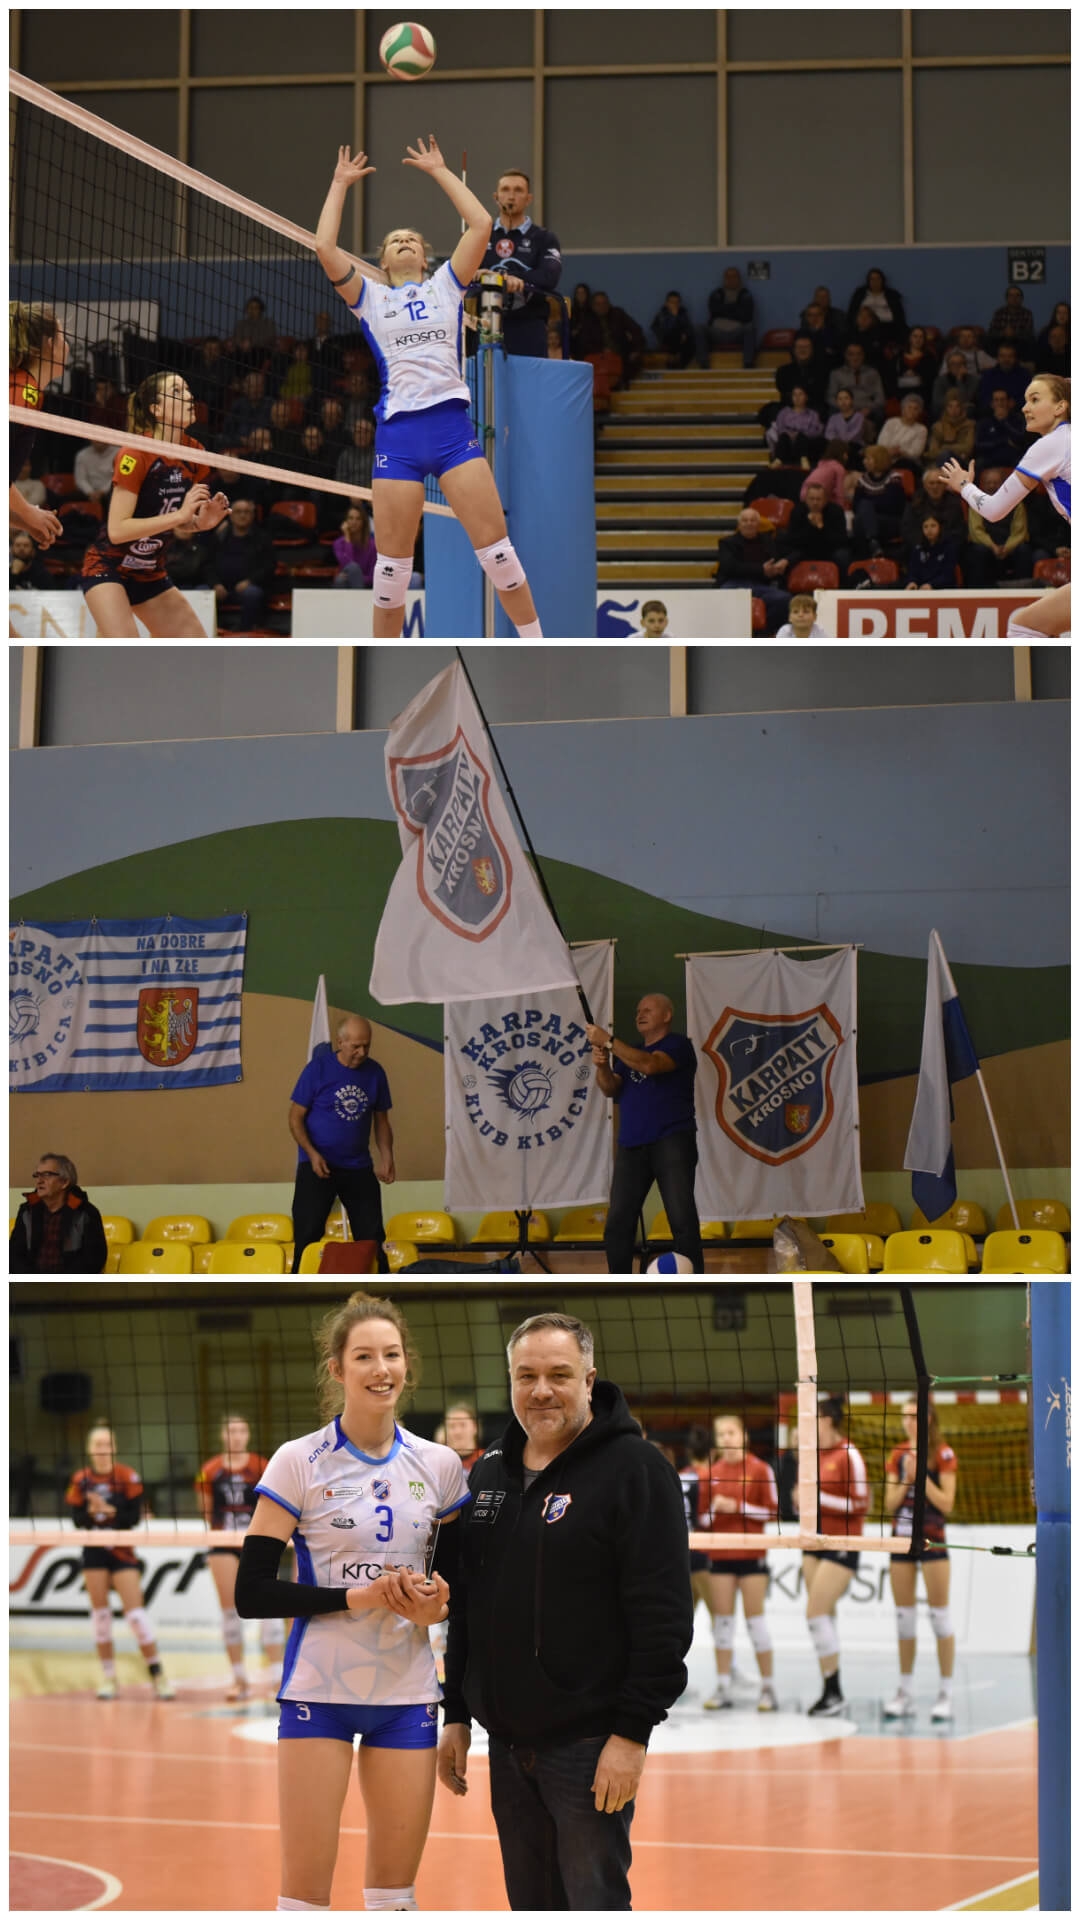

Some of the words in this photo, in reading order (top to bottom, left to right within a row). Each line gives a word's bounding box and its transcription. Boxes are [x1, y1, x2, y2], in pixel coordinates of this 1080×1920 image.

[1012, 260, 1044, 281] B2
[404, 300, 429, 321] 12
[375, 454, 389, 468] 12
[428, 751, 476, 875] KARPATY
[137, 937, 156, 951] NA
[160, 934, 206, 949] DOBRE
[142, 959, 147, 975] I
[151, 959, 170, 974] NA
[175, 958, 199, 973] ZŁE
[460, 1009, 593, 1062] KARPATY
[477, 1031, 576, 1072] KROSNO
[728, 1026, 828, 1114] KARPATY
[465, 1092, 509, 1147] KLUB
[517, 1086, 588, 1150] KIBICA
[747, 1069, 816, 1129] KROSNO
[375, 1504, 394, 1542] 3
[295, 1703, 312, 1721] 3
